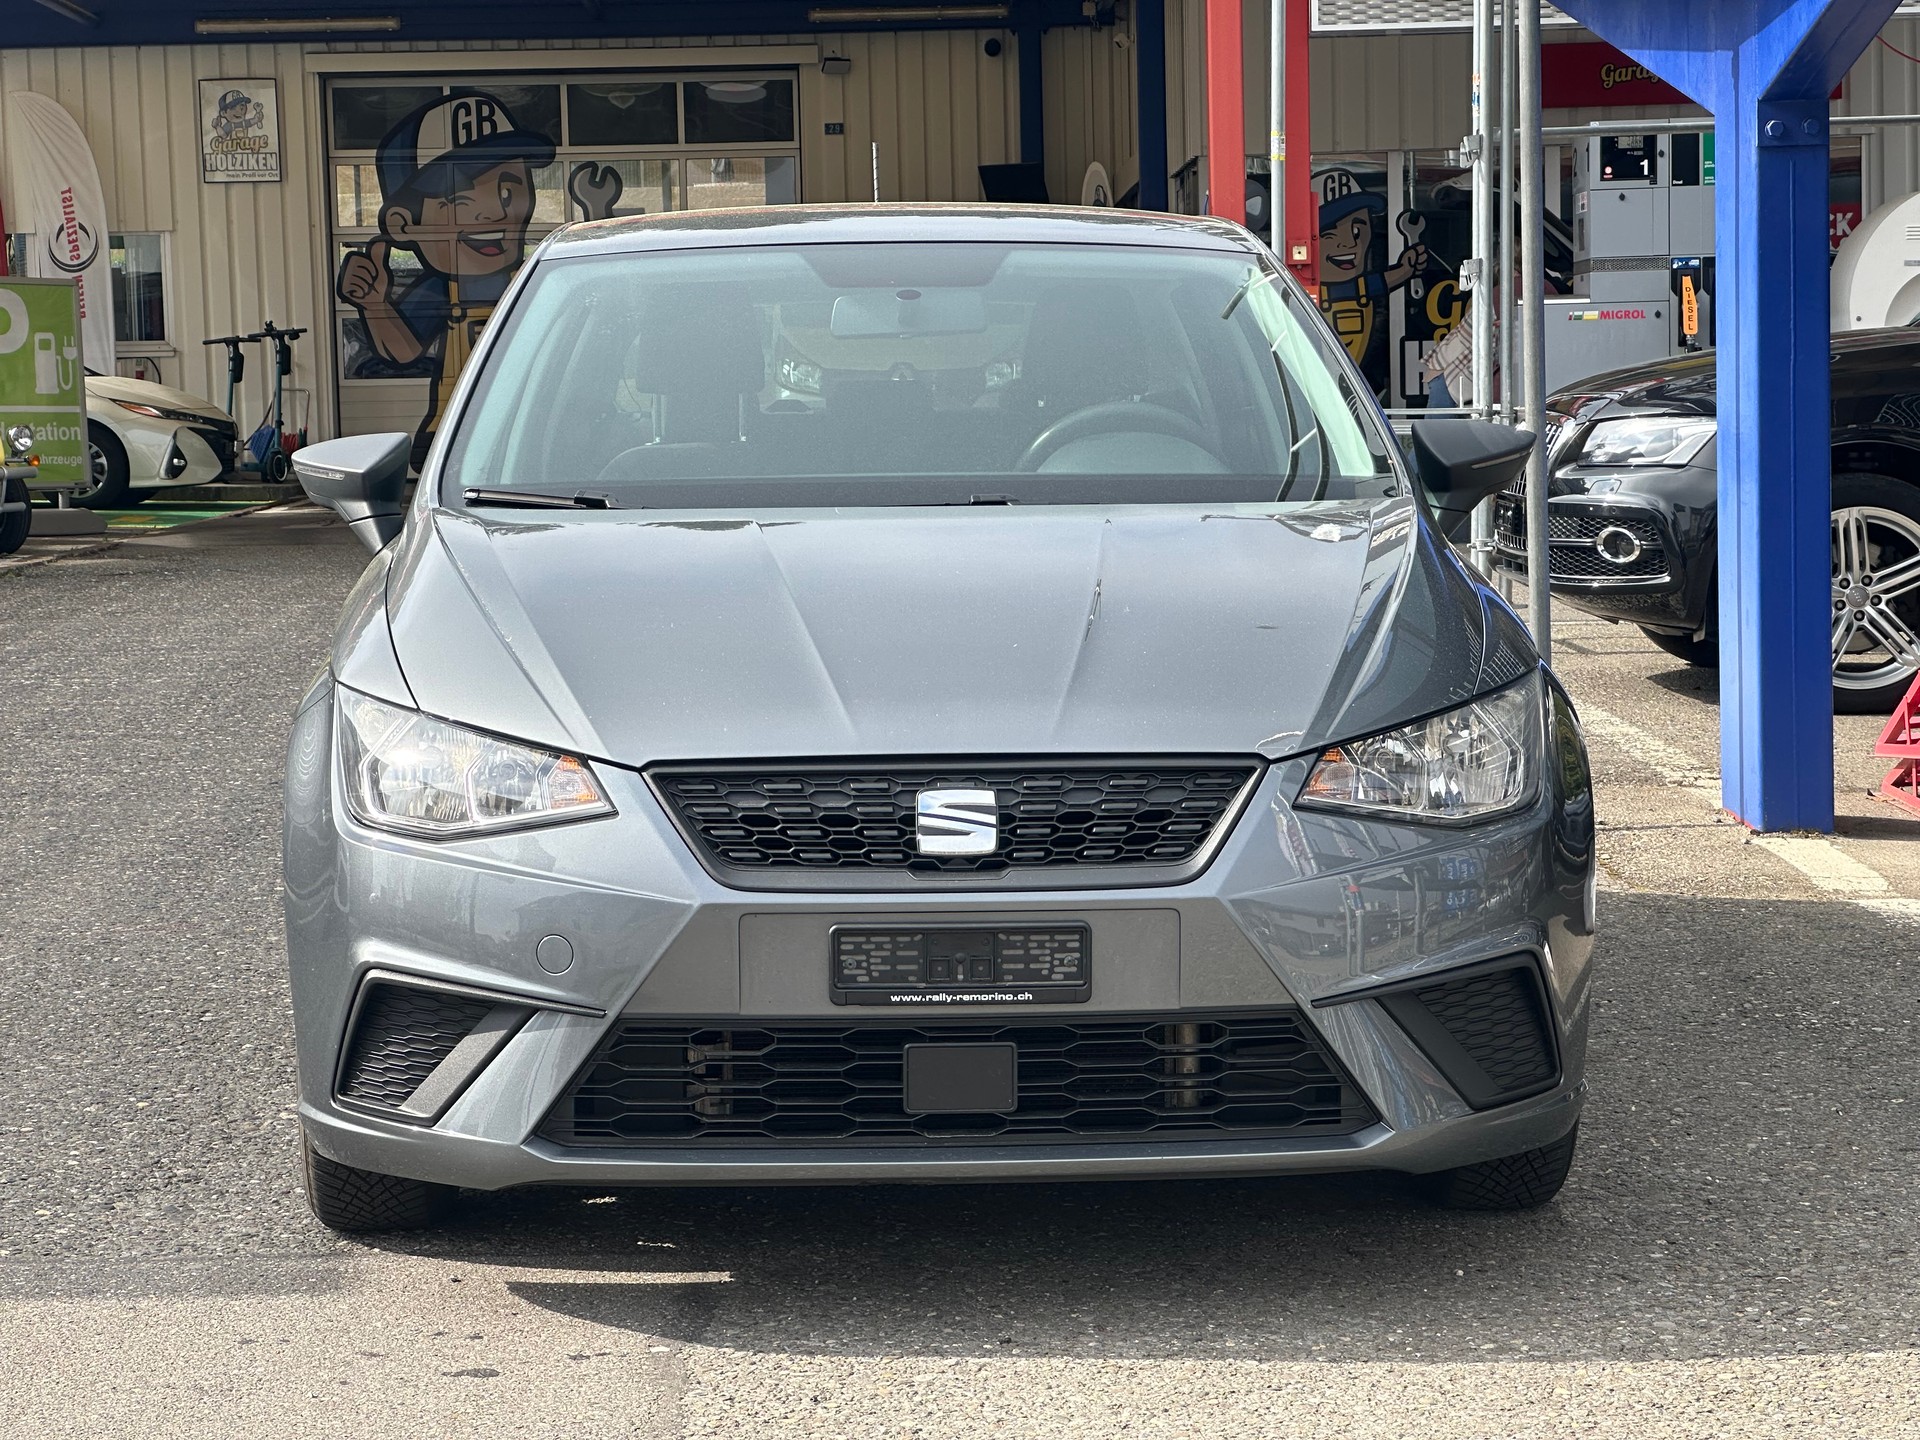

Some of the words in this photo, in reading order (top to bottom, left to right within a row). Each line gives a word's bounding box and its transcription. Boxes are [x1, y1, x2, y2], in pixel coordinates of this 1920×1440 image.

[452, 99, 498, 147] GB
[210, 135, 268, 154] Garage
[205, 153, 278, 171] HOLZIKEN
[1640, 159, 1649, 176] 1
[1323, 172, 1352, 202] GB
[1600, 309, 1646, 320] MIGROL
[1685, 286, 1693, 331] DIESEL
[890, 992, 1033, 1003] www.rally-remorino.ch
